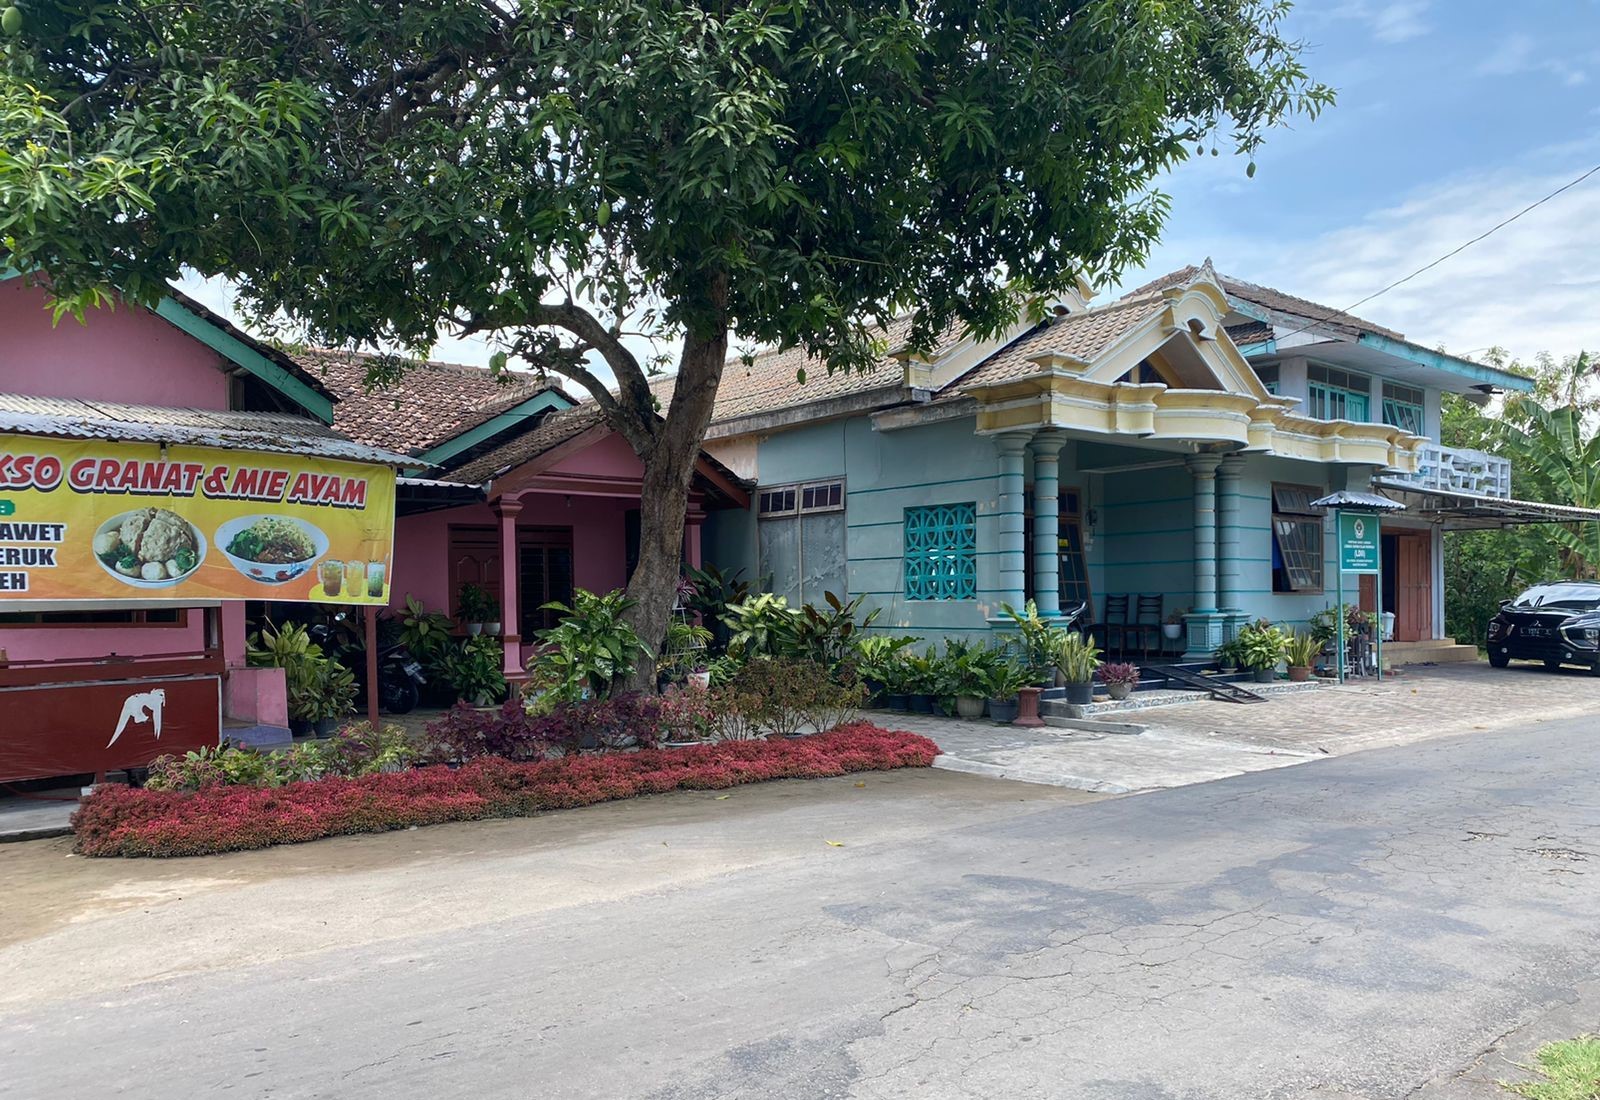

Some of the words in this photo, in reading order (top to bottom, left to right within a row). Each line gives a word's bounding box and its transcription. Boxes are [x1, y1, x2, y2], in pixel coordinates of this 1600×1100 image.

[70, 458, 203, 492] GRANAT
[204, 466, 228, 494] &
[231, 468, 289, 498] MIE
[289, 473, 367, 505] AYAM
[0, 523, 65, 541] AWET
